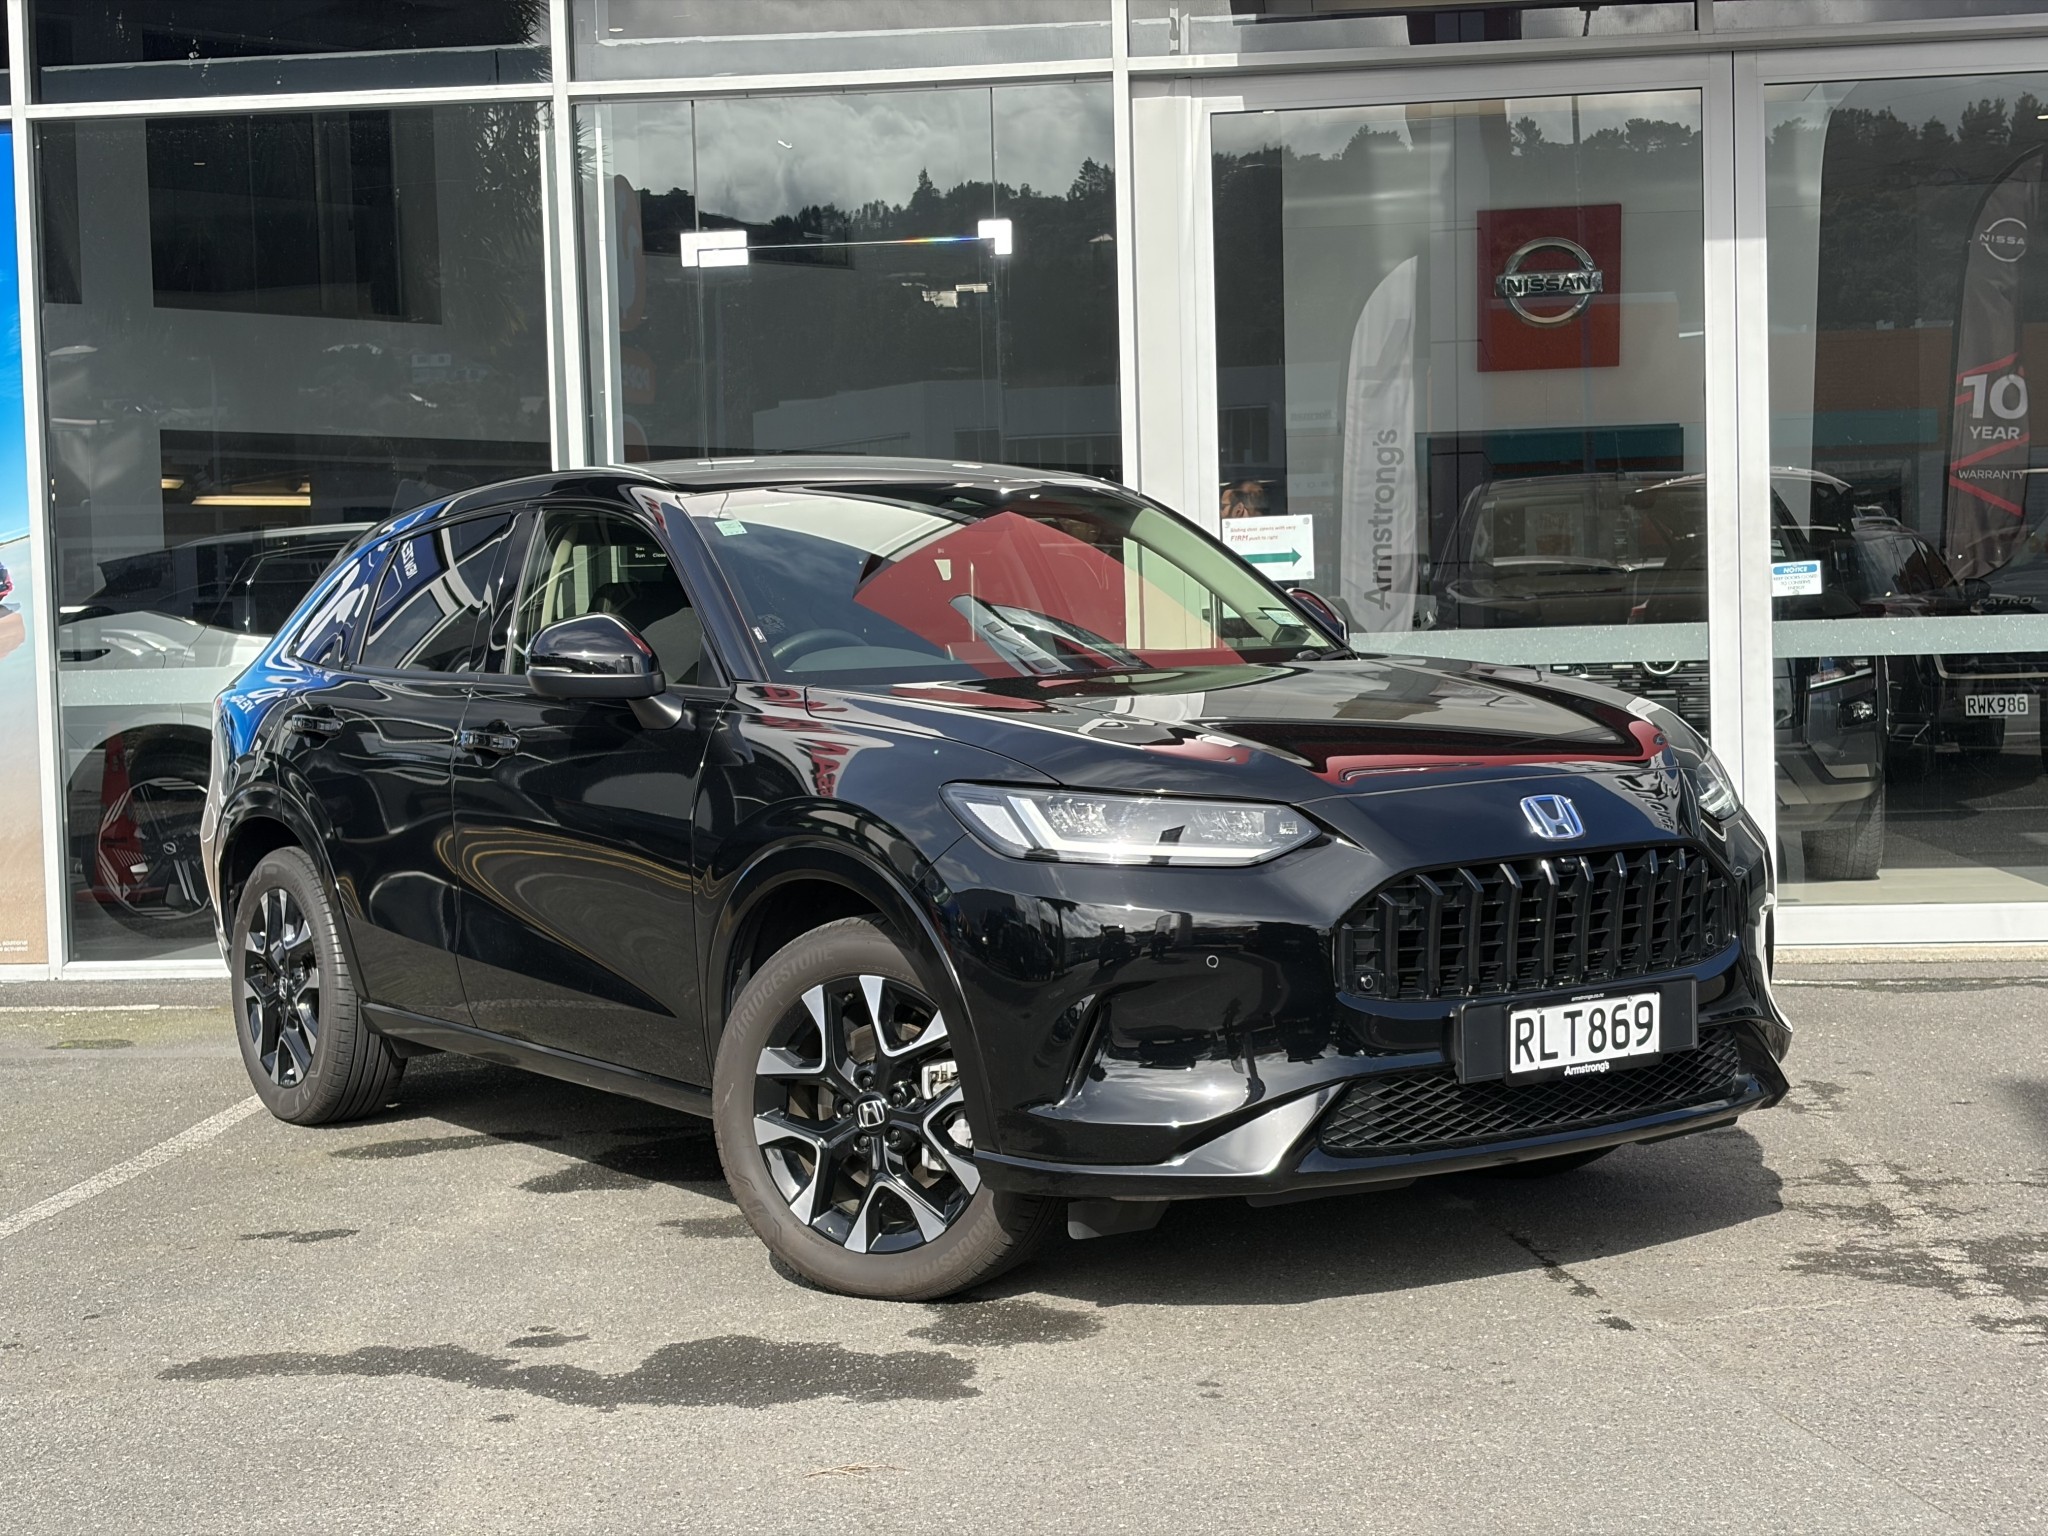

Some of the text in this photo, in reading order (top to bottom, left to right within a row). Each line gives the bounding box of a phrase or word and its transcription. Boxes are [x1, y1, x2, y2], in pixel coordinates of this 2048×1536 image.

[1979, 232, 2026, 246] NISSA
[1506, 276, 1591, 294] NISSAN
[1962, 373, 2029, 420] 10
[1969, 425, 2020, 440] YEAR
[1958, 469, 2025, 481] WARRANTY
[1363, 428, 1405, 612] Armstrong's
[1230, 534, 1249, 542] FIRM
[1976, 596, 2044, 605] PATROL
[1967, 696, 2027, 714] RWK986
[1514, 999, 1654, 1066] RLT869
[1563, 1060, 1610, 1076] Armstrong's
